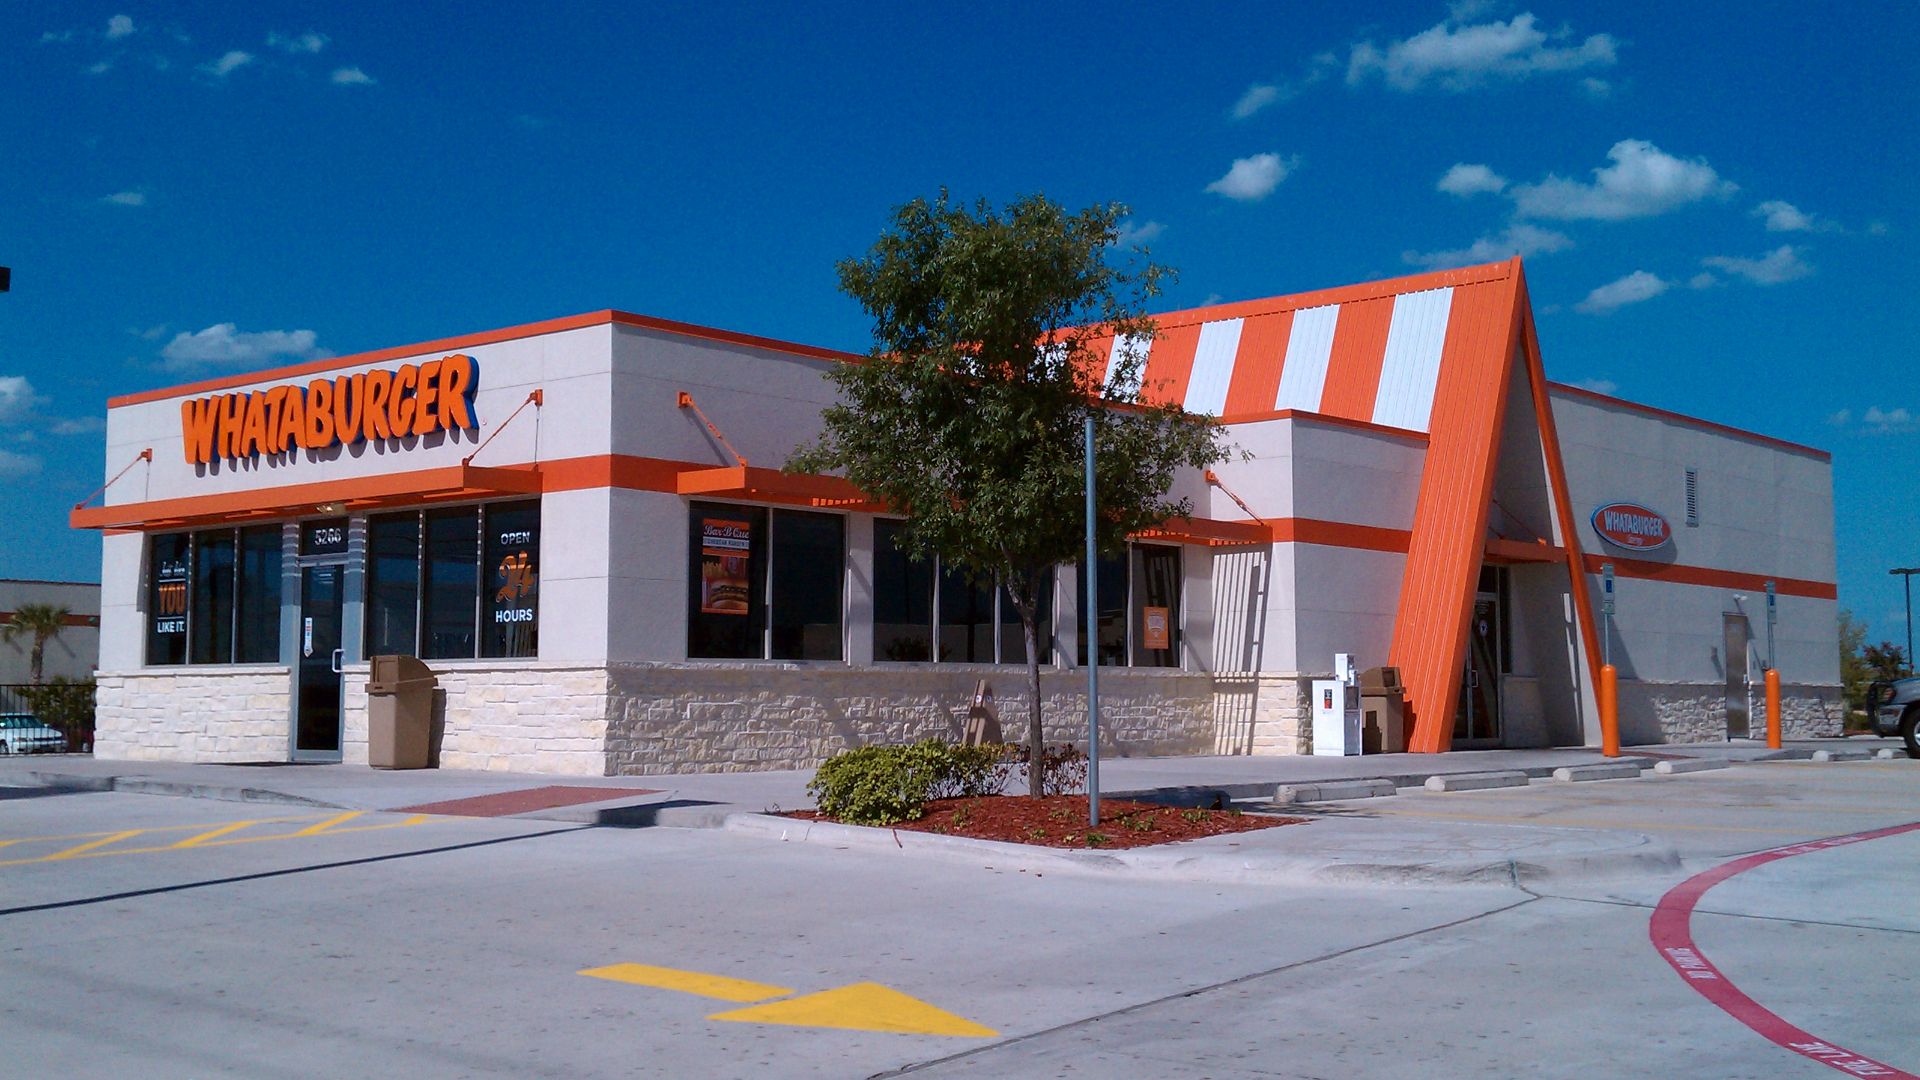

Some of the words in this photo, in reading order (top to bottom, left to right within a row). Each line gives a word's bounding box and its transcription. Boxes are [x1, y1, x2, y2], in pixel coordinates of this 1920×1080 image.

[181, 354, 478, 464] WHATABURGER
[1604, 511, 1664, 537] WHATABURGER
[315, 528, 341, 545] 5266
[501, 532, 530, 544] OPEN
[496, 551, 535, 602] 24
[159, 583, 186, 615] YOU
[496, 609, 532, 622] HOURS
[157, 622, 175, 633] LIKE
[175, 621, 185, 632] IT.
